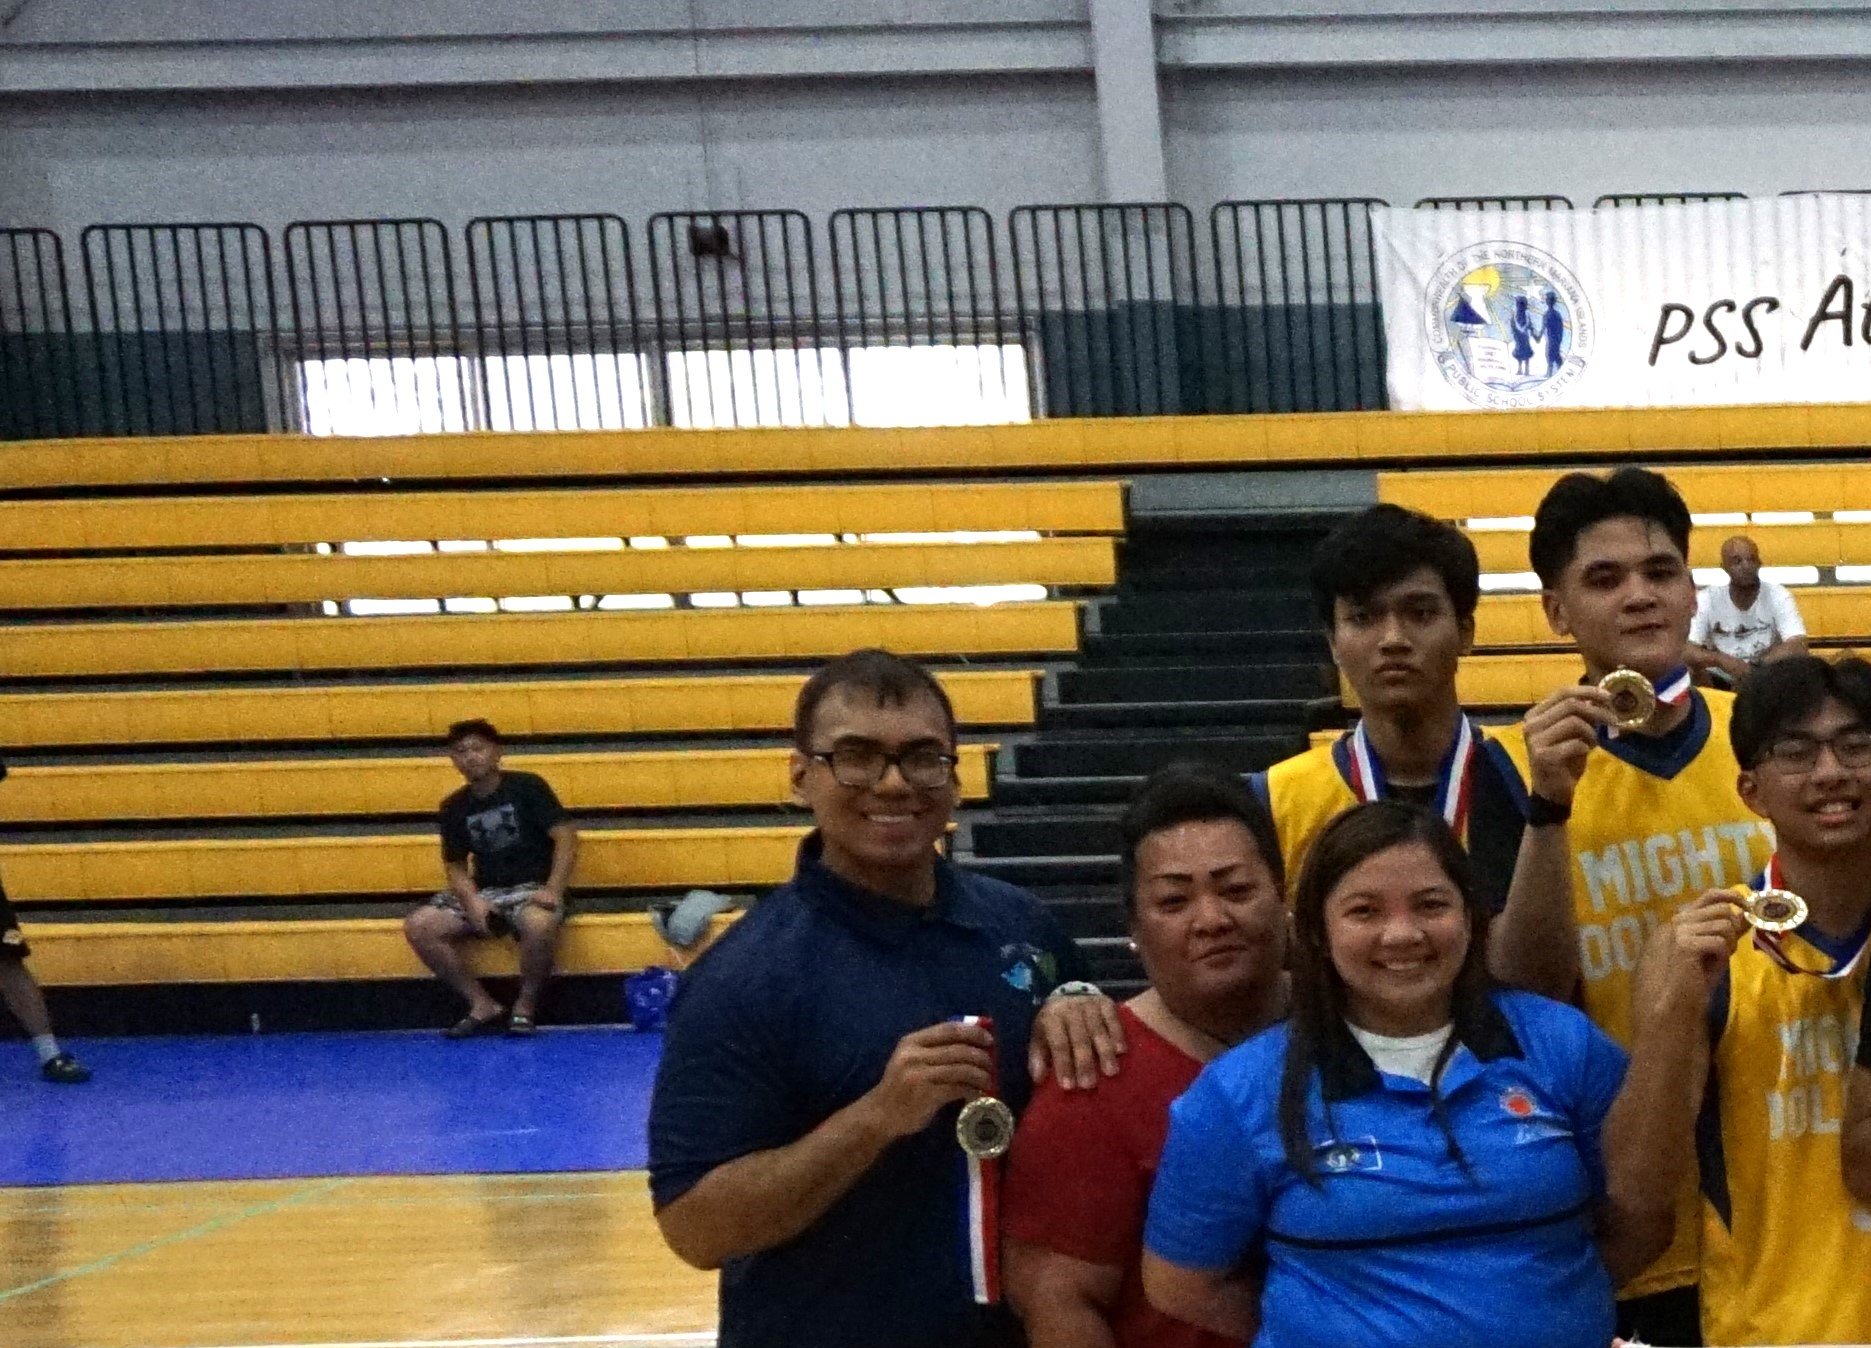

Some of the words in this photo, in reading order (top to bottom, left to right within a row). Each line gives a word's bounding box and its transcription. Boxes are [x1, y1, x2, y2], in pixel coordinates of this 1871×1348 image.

[1649, 296, 1780, 366] PSS
[1448, 363, 1480, 398] PUBLIC
[1487, 393, 1534, 408] SCHOOL
